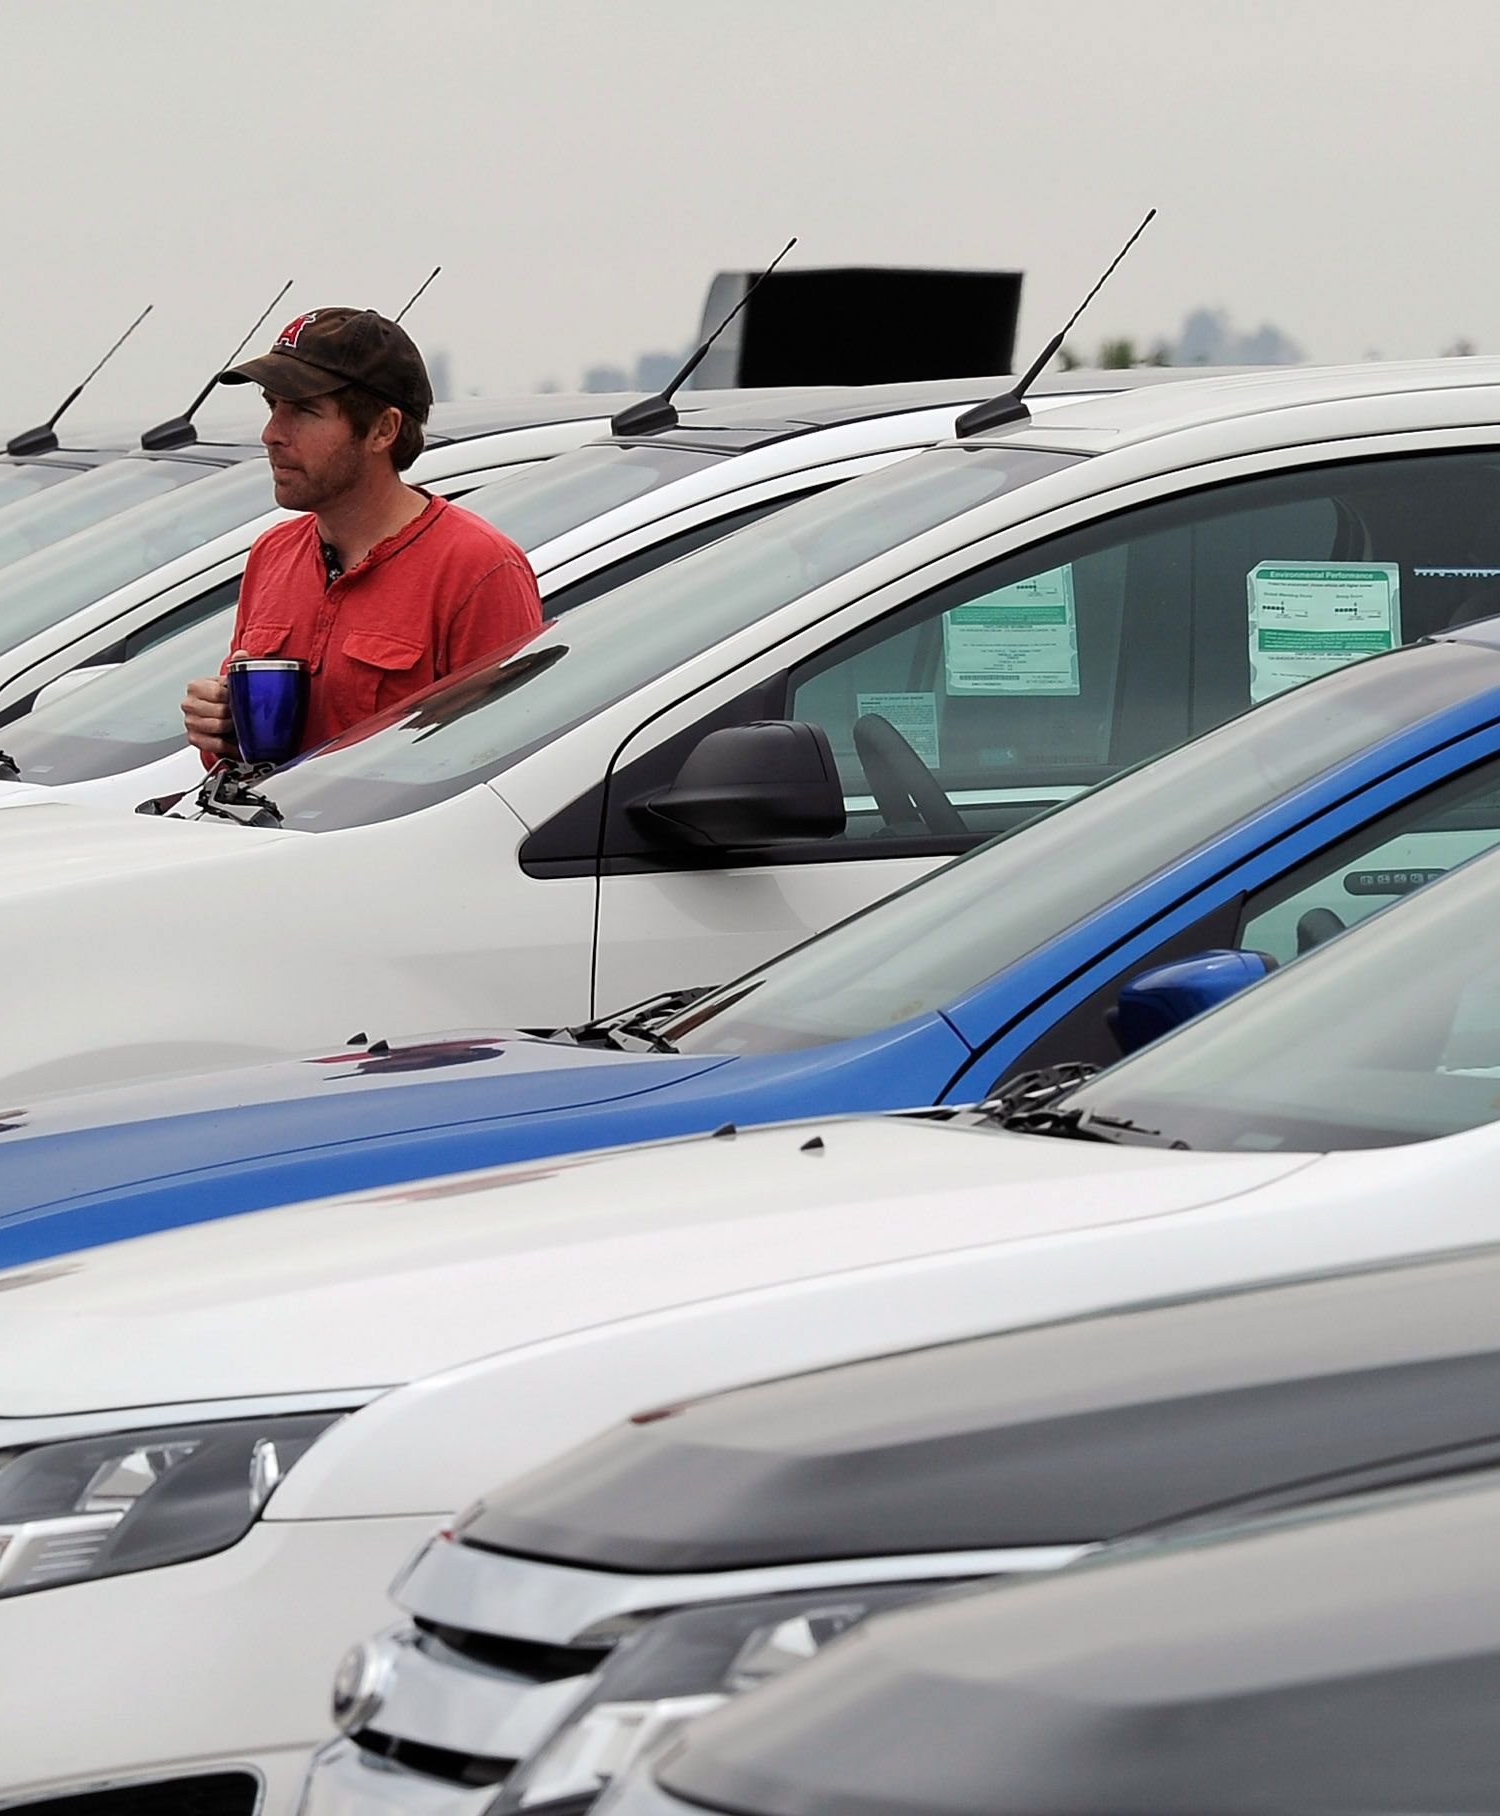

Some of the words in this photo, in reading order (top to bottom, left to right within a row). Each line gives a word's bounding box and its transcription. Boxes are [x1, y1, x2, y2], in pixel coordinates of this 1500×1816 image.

[274, 313, 316, 348] A
[1270, 570, 1325, 579] Environmental
[1325, 571, 1373, 580] Performance
